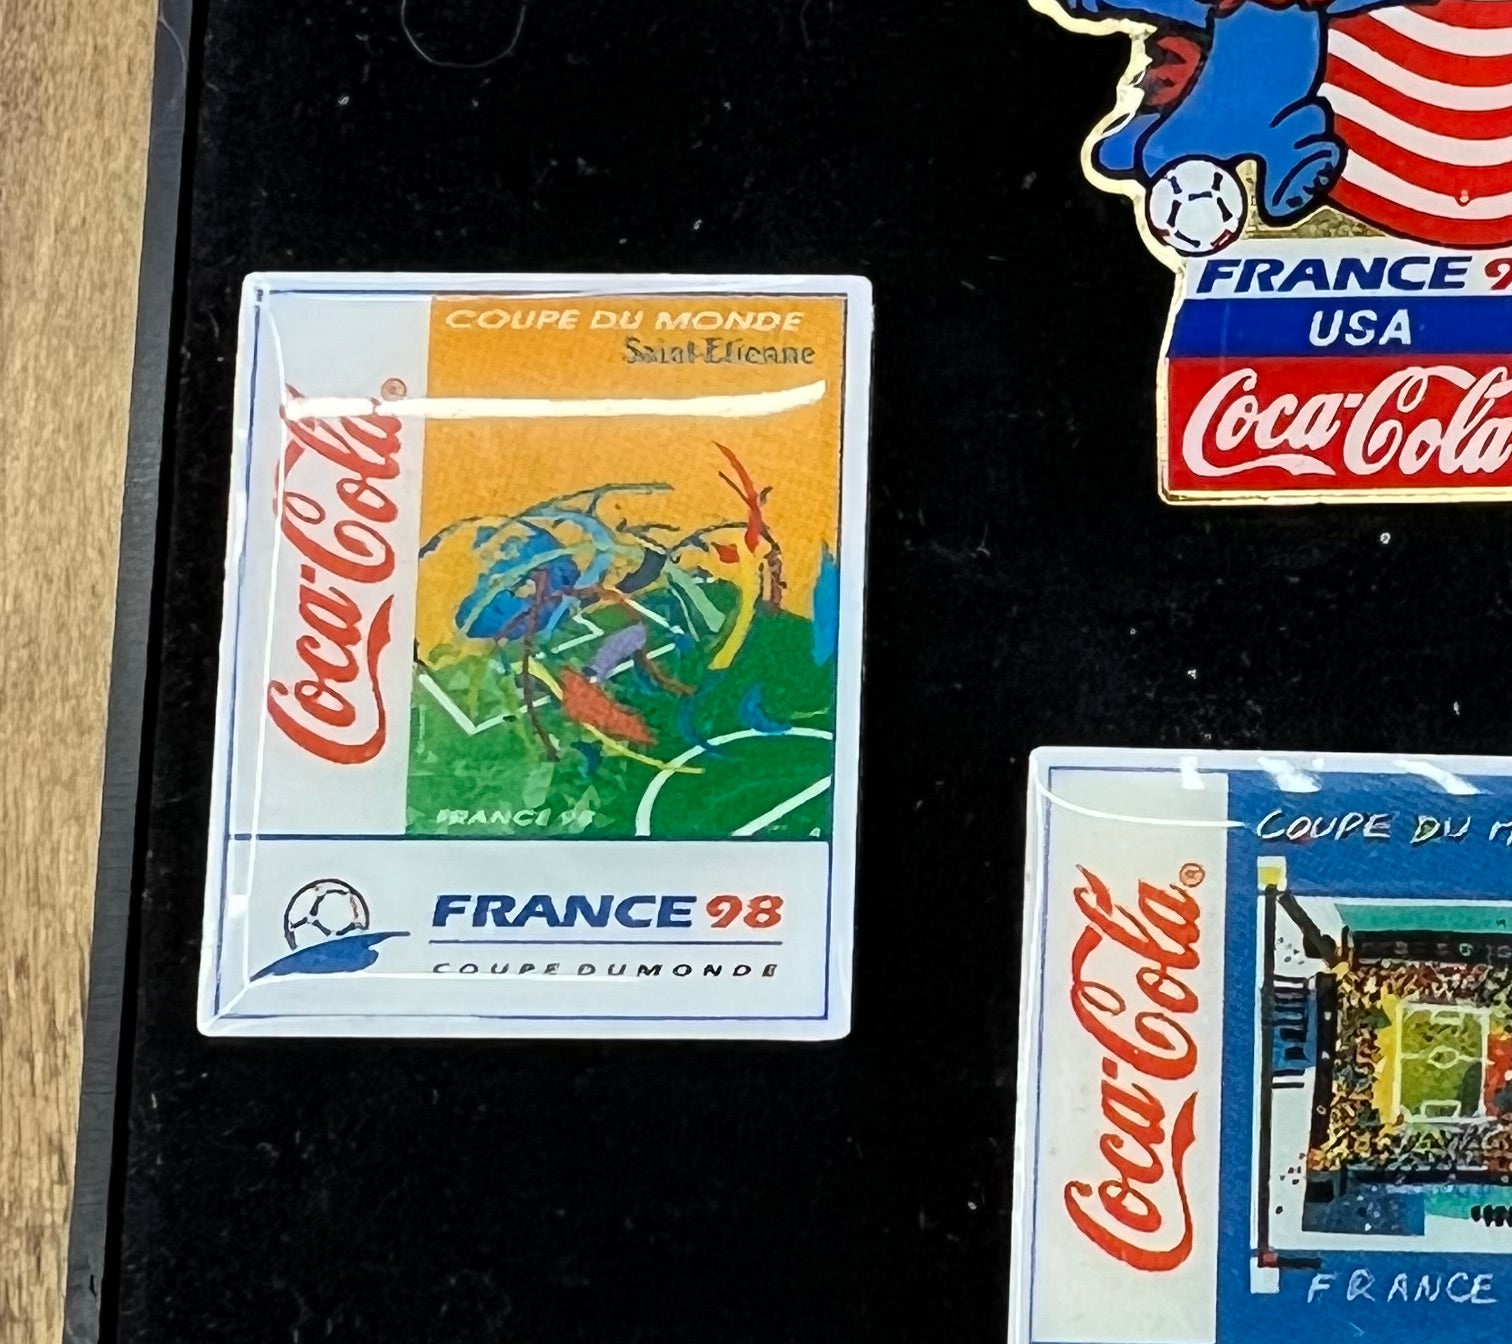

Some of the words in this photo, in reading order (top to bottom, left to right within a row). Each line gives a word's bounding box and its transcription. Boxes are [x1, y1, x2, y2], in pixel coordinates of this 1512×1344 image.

[1196, 256, 1473, 294] FRANCE
[445, 309, 581, 330] COUPE
[590, 310, 644, 331] DU
[655, 311, 805, 332] MONDE
[1308, 309, 1413, 347] USA
[1255, 808, 1393, 841] COUPE
[1409, 815, 1472, 844] DU
[432, 895, 698, 928] FRANCE
[705, 895, 785, 928] 98
[432, 963, 560, 975] COUPE
[1307, 1268, 1497, 1304] FRANCE
